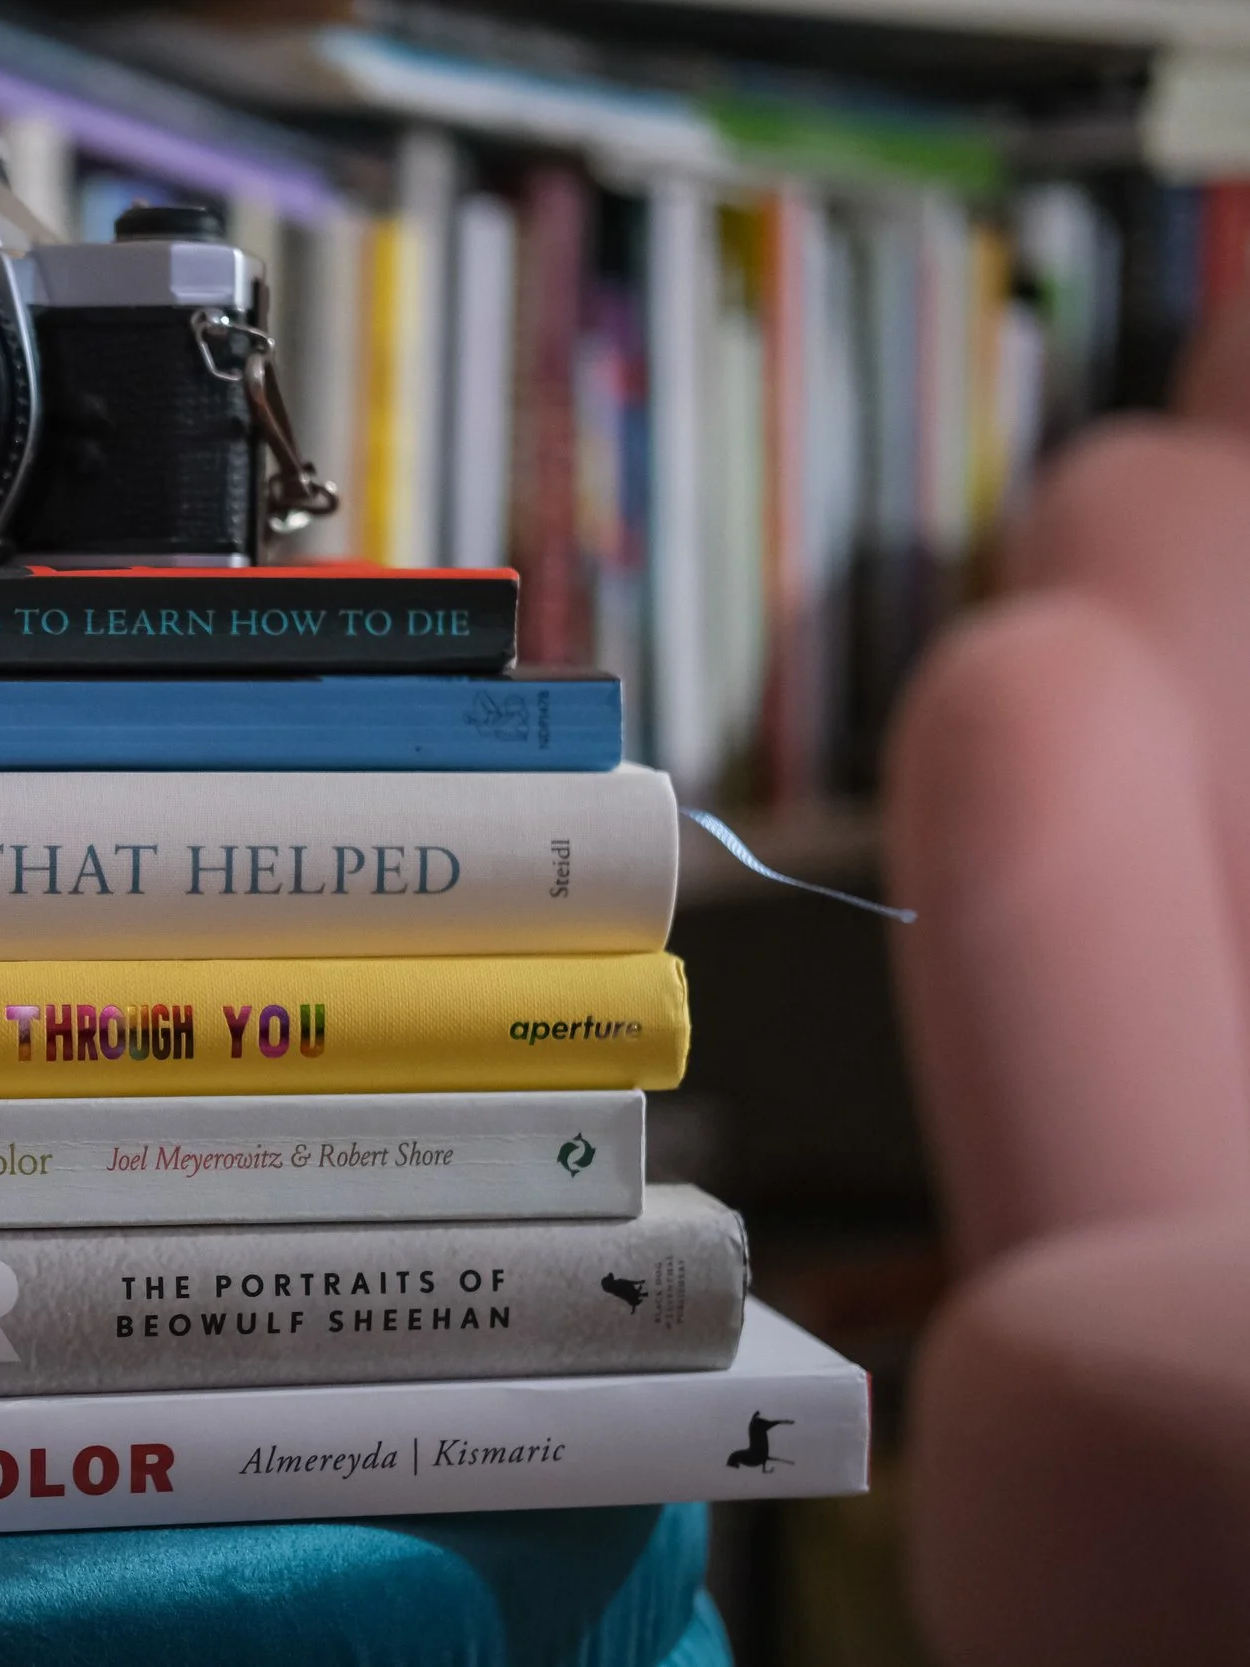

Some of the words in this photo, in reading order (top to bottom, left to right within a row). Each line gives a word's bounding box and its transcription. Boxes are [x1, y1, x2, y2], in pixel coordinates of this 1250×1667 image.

[15, 609, 68, 635] TO
[85, 610, 213, 635] LEARN
[231, 610, 325, 635] HOW
[340, 611, 391, 635] TO
[409, 611, 469, 635] DIE
[186, 845, 461, 895] HELPED
[550, 839, 570, 897] Steidl
[5, 1004, 194, 1061] THROUGH
[223, 1003, 326, 1058] YOU
[508, 1016, 643, 1045] aperture
[107, 1146, 148, 1171] Joel
[156, 1144, 283, 1178] Meyerowitz
[291, 1144, 311, 1167] &
[319, 1142, 388, 1167] Robert
[395, 1141, 453, 1166] Shore
[122, 1276, 189, 1300] THE
[216, 1271, 434, 1298] PORTRAITS
[460, 1270, 503, 1292] OF
[117, 1312, 303, 1337] BEOWULF
[329, 1307, 509, 1332] SHEEHAN
[239, 1441, 397, 1479] Almereyda
[434, 1438, 565, 1466] Kismaric
